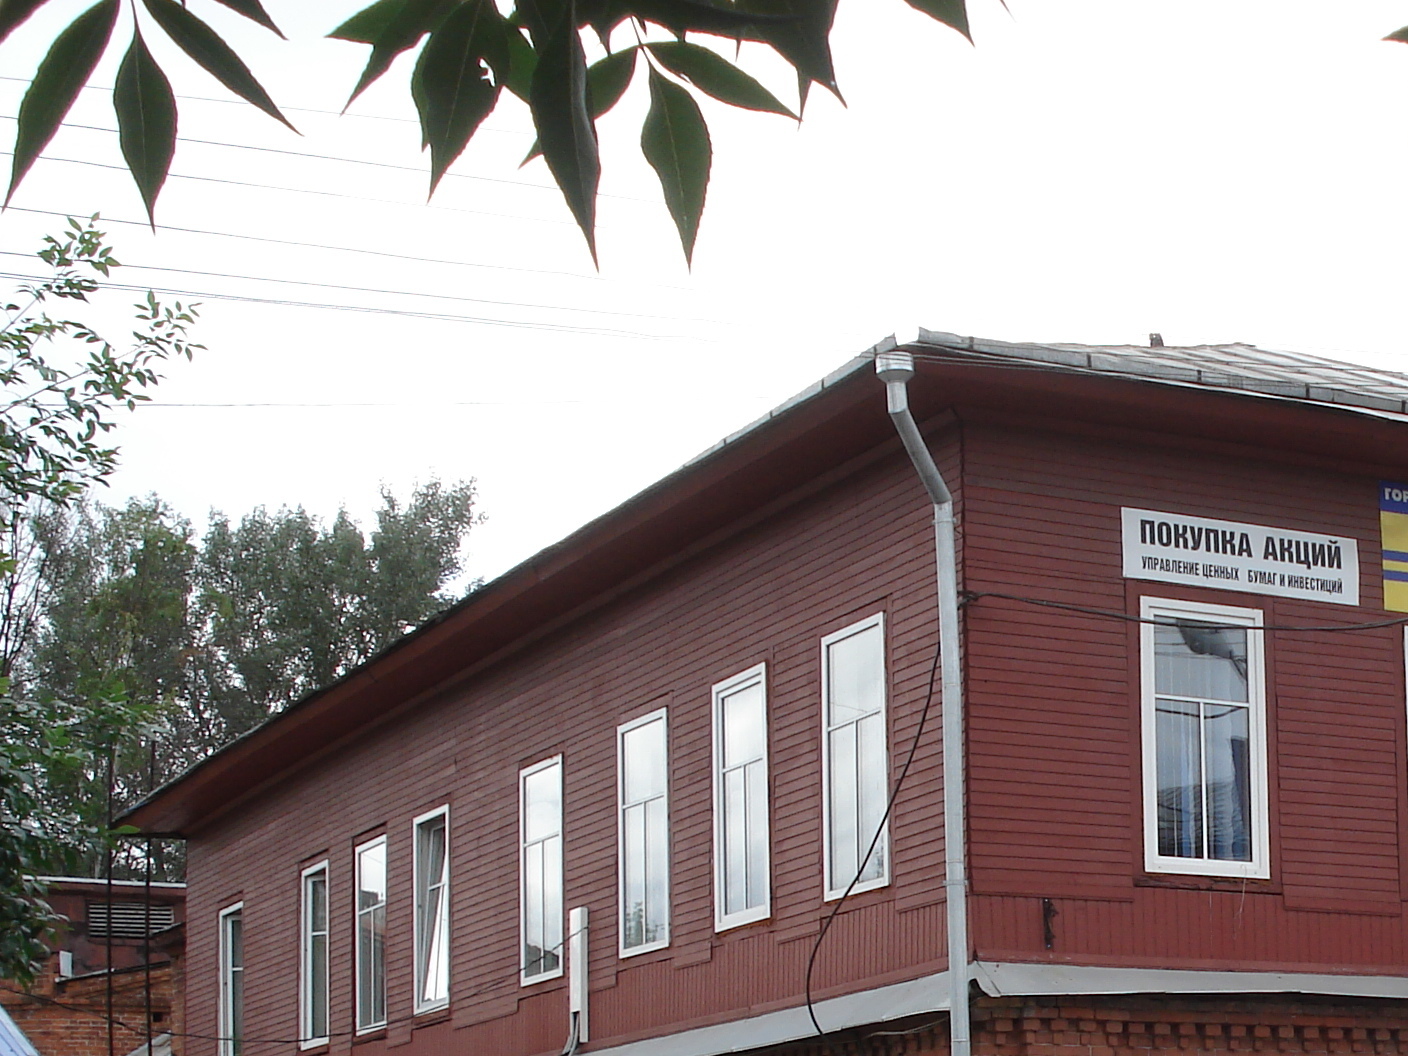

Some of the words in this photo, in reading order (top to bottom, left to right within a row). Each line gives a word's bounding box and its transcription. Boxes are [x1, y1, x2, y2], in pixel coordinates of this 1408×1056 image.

[1139, 518, 1253, 558] ПОКУПКА
[1263, 536, 1343, 570] АКЦИЙ
[1141, 556, 1200, 576] УПРАВЛЕНИЕ
[1202, 563, 1240, 582] ЦЕННЫХ
[1247, 569, 1278, 586] БУМАГ
[1279, 574, 1286, 587] И
[1287, 573, 1343, 595] ИНВЕСТИЦИЙ
